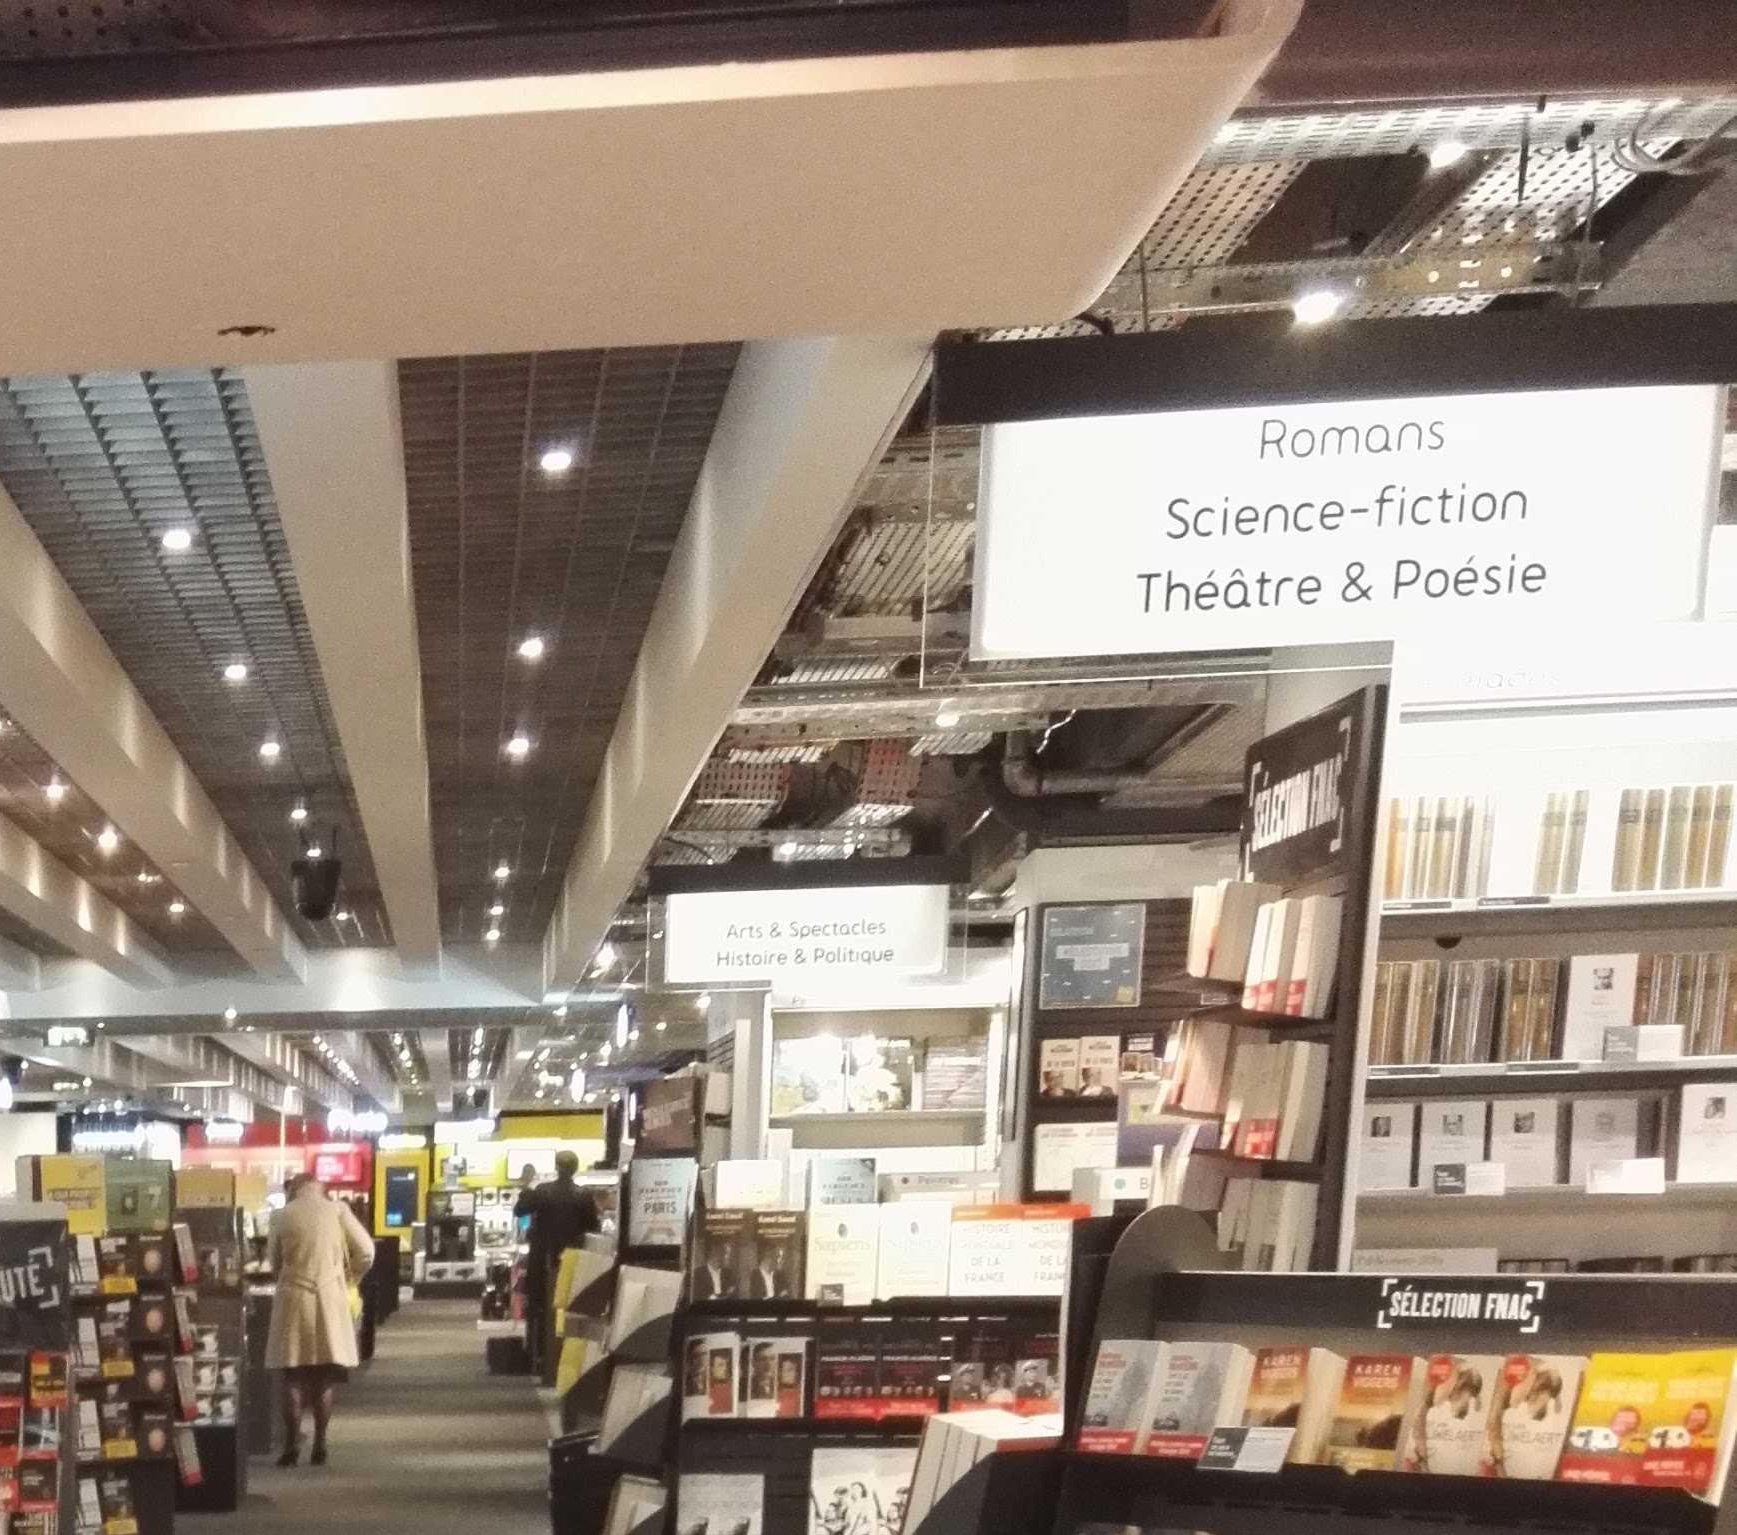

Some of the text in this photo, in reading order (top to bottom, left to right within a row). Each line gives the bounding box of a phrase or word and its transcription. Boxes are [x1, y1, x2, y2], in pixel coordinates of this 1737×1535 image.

[1259, 418, 1446, 460] Romans
[1165, 482, 1528, 540] Science-fiction
[1136, 553, 1547, 614] Théâtre & Poésie
[726, 918, 887, 940] Arts & Spectacles
[716, 946, 895, 967] Histoire & Politique
[1389, 1284, 1534, 1321] SÉLECTION FNAC
[1354, 1363, 1402, 1375] KAREN
